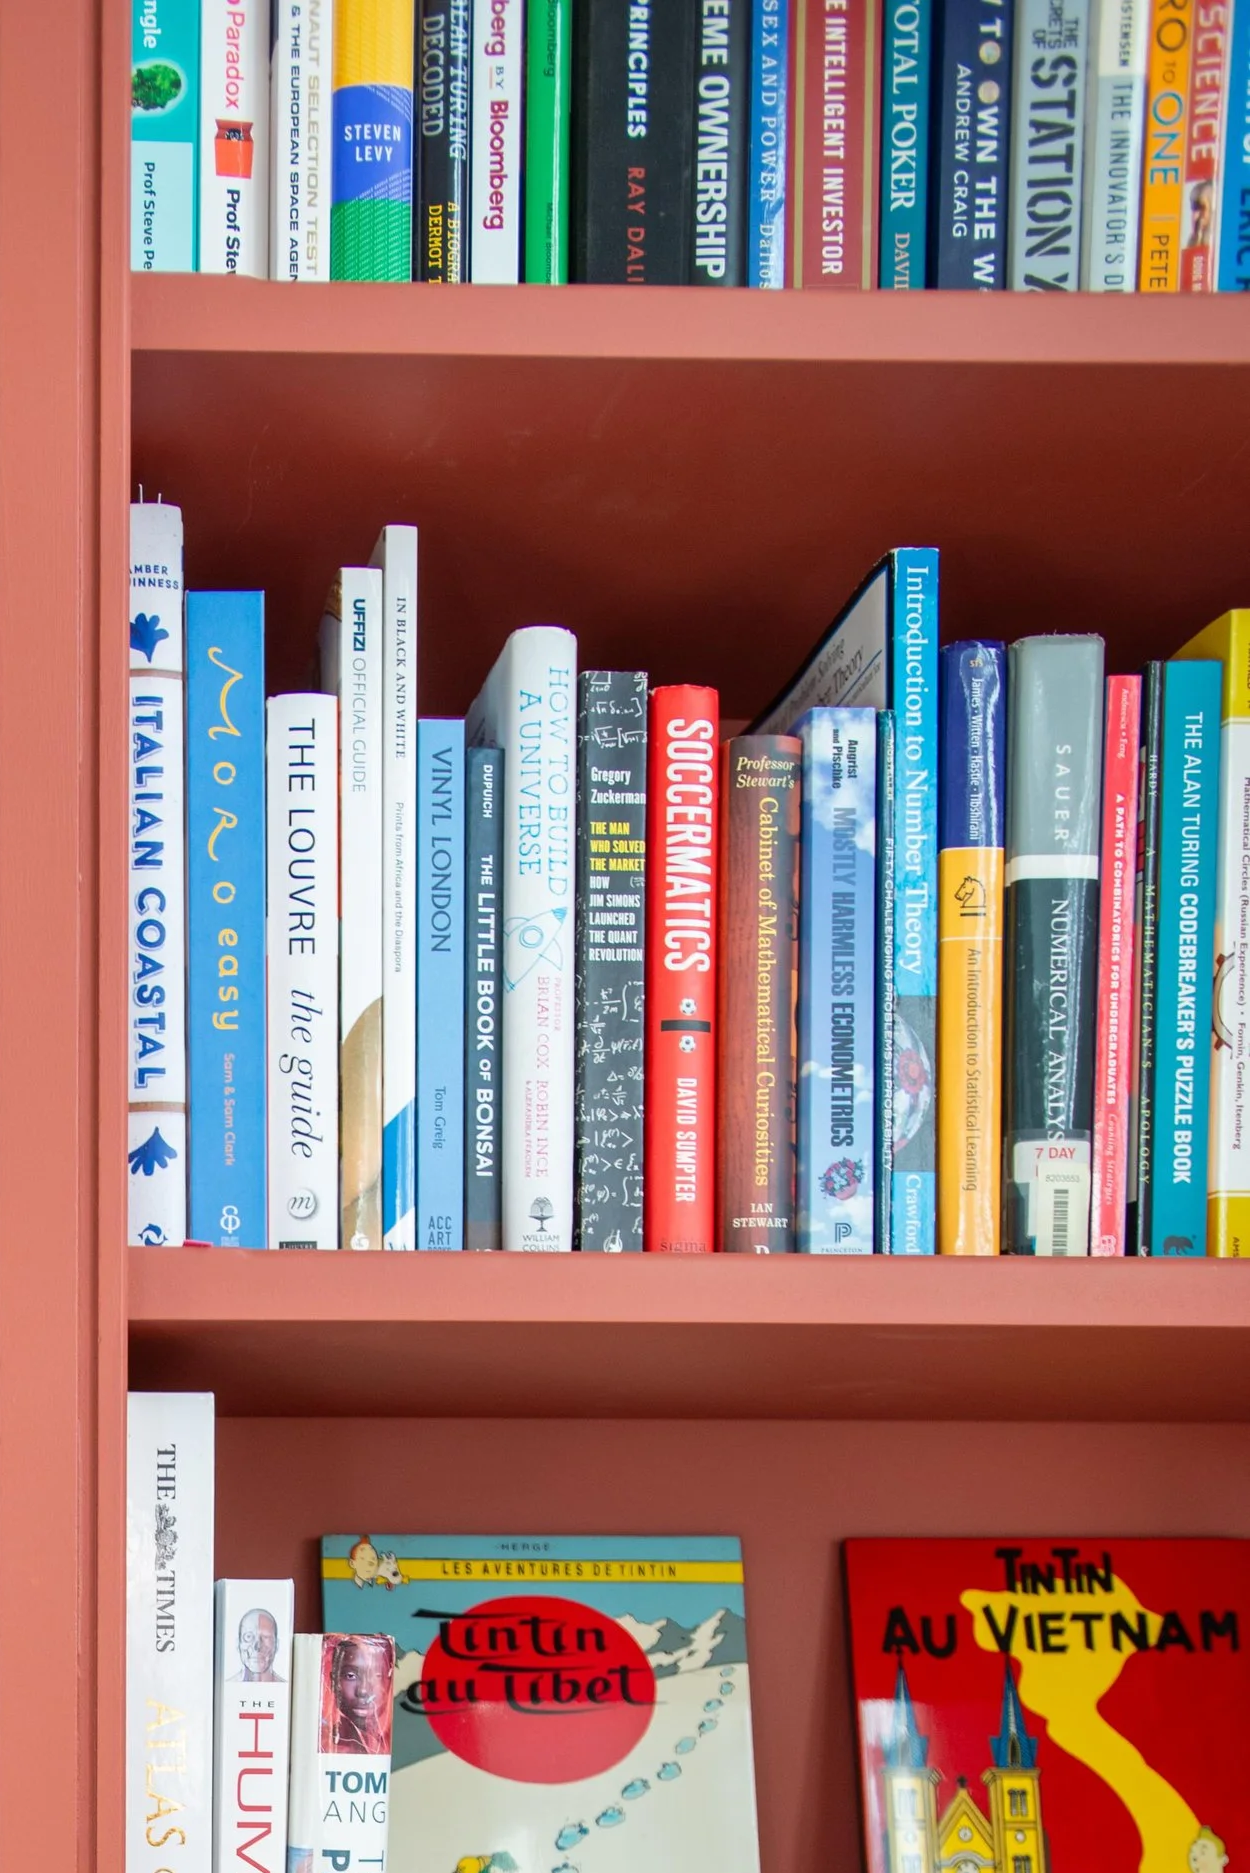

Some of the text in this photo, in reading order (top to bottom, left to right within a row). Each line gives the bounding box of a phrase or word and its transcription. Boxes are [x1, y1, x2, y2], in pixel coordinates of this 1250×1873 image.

[225, 4, 245, 110] Paradox
[422, 14, 445, 137] DECODED
[1191, 5, 1226, 162] SCIENCE
[306, 75, 321, 275] SELECTION TEST
[344, 124, 401, 142] STEVEN
[355, 146, 394, 162] LEVY
[483, 100, 509, 230] Bloomberg
[696, 76, 730, 278] OWNERSHIP
[822, 17, 848, 275] INTELLIGENT INVESTOR
[890, 103, 918, 212] POKER
[953, 63, 972, 238] ANDREW CRAIG
[1025, 54, 1077, 258] STATION
[1105, 83, 1134, 265] THE INNOVATOR'S
[226, 189, 241, 232] Prof
[429, 205, 443, 268] DERMOT
[590, 766, 631, 786] Gregory
[735, 754, 795, 774] Professor
[735, 774, 795, 790] Stewart's
[903, 565, 930, 975] Introduction to Number Theory
[969, 677, 984, 841] James Witten Hastie Tibshirani
[1053, 743, 1072, 843] SAUER
[132, 695, 167, 1090] ITALIAN COASTAL
[430, 747, 453, 953] VINYL LONDON
[664, 718, 713, 973] SOCCERMATICS
[278, 718, 324, 1160] THE LOUVRE the guide
[754, 795, 779, 1187] Cabinet of Mathematical Curiosities
[1172, 711, 1203, 1184] THE ALAN TURING CODEBREAKER'S PUZZLE BOOK
[475, 854, 495, 1177] THE LITTLE BOOK OF BONSAI
[674, 1076, 697, 1203] DAVID SUMPTER
[732, 1216, 789, 1229] STEWART
[750, 1202, 773, 1214] IAN
[155, 1443, 177, 1653] THE TIMES
[441, 1561, 677, 1577] LES AVENTURES DE TINTIN
[400, 1661, 669, 1716] au Tibet
[410, 1608, 607, 1661] Tintin
[881, 1605, 959, 1660] AU
[981, 1603, 1243, 1655] VIETNAM
[239, 1700, 275, 1708] THE
[144, 1696, 189, 1849] ATLAS
[322, 1800, 388, 1824] ANG
[324, 1770, 388, 1795] TOM
